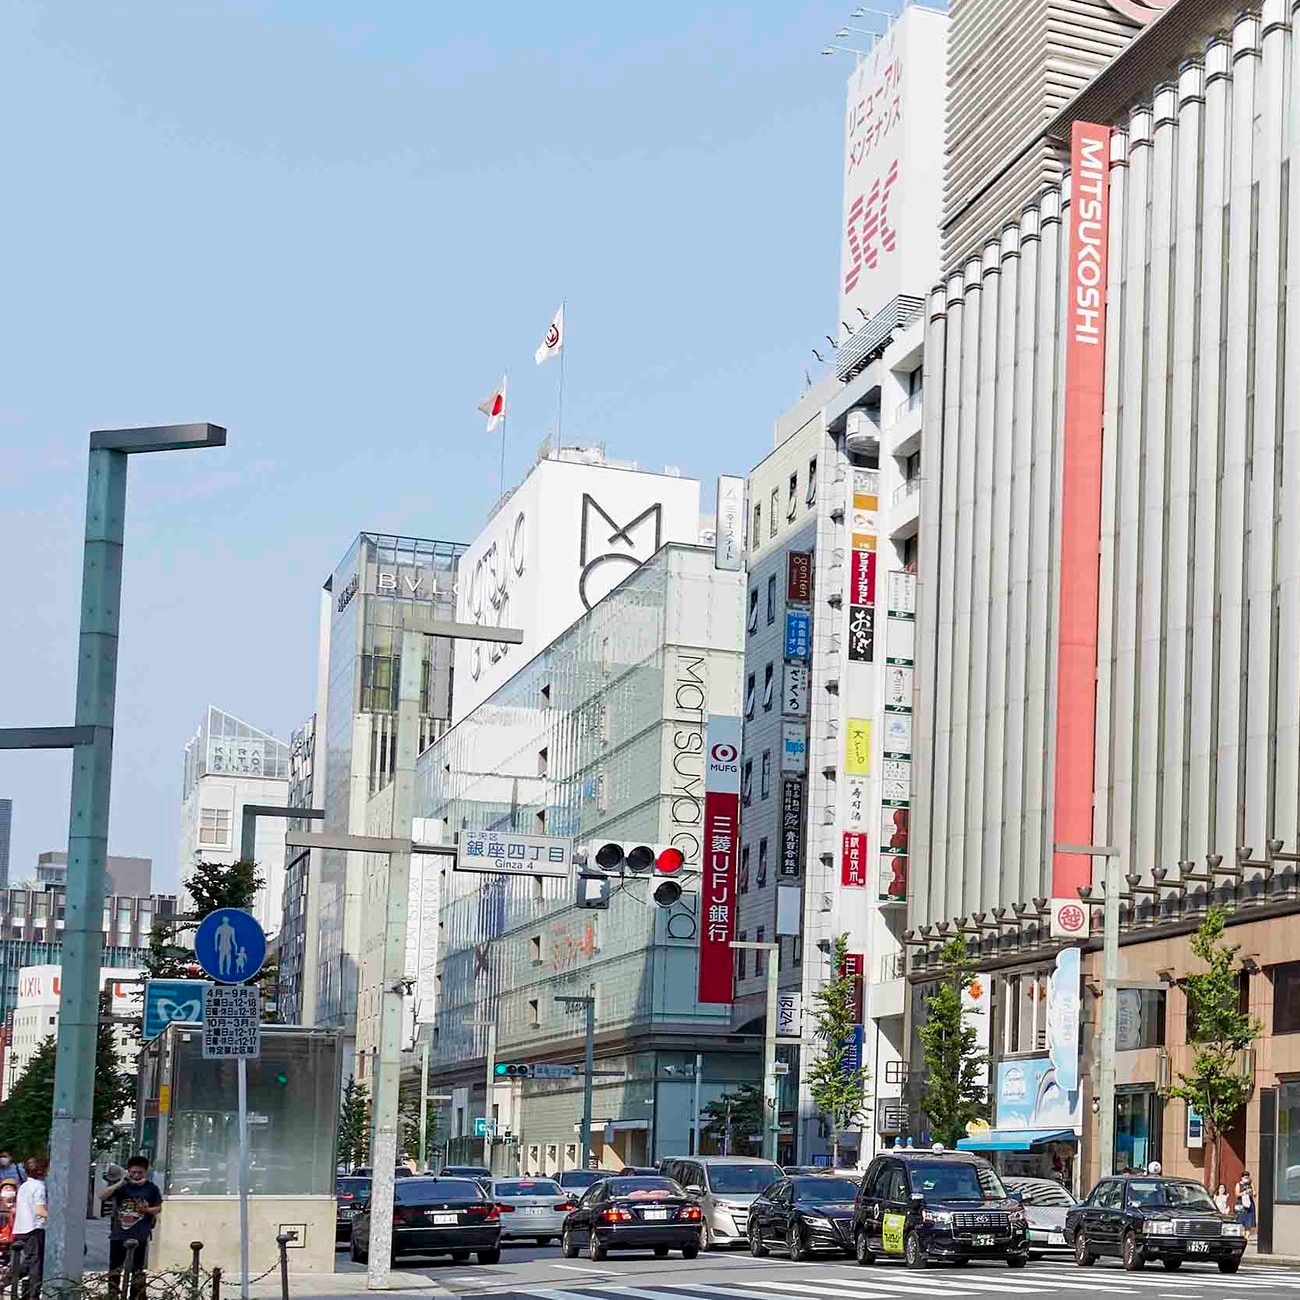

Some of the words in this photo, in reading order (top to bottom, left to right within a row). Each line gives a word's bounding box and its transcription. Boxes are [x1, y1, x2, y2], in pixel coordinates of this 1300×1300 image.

[1074, 137, 1105, 346] MITSUKOSHI
[214, 747, 260, 756] KIRA
[214, 755, 260, 765] RITO
[710, 764, 738, 773] MUFG
[466, 840, 564, 863] 銀座四丁目
[494, 859, 523, 869] Ginza
[708, 815, 731, 943] 三菱UFJ銀行
[20, 977, 41, 998] LIXIL
